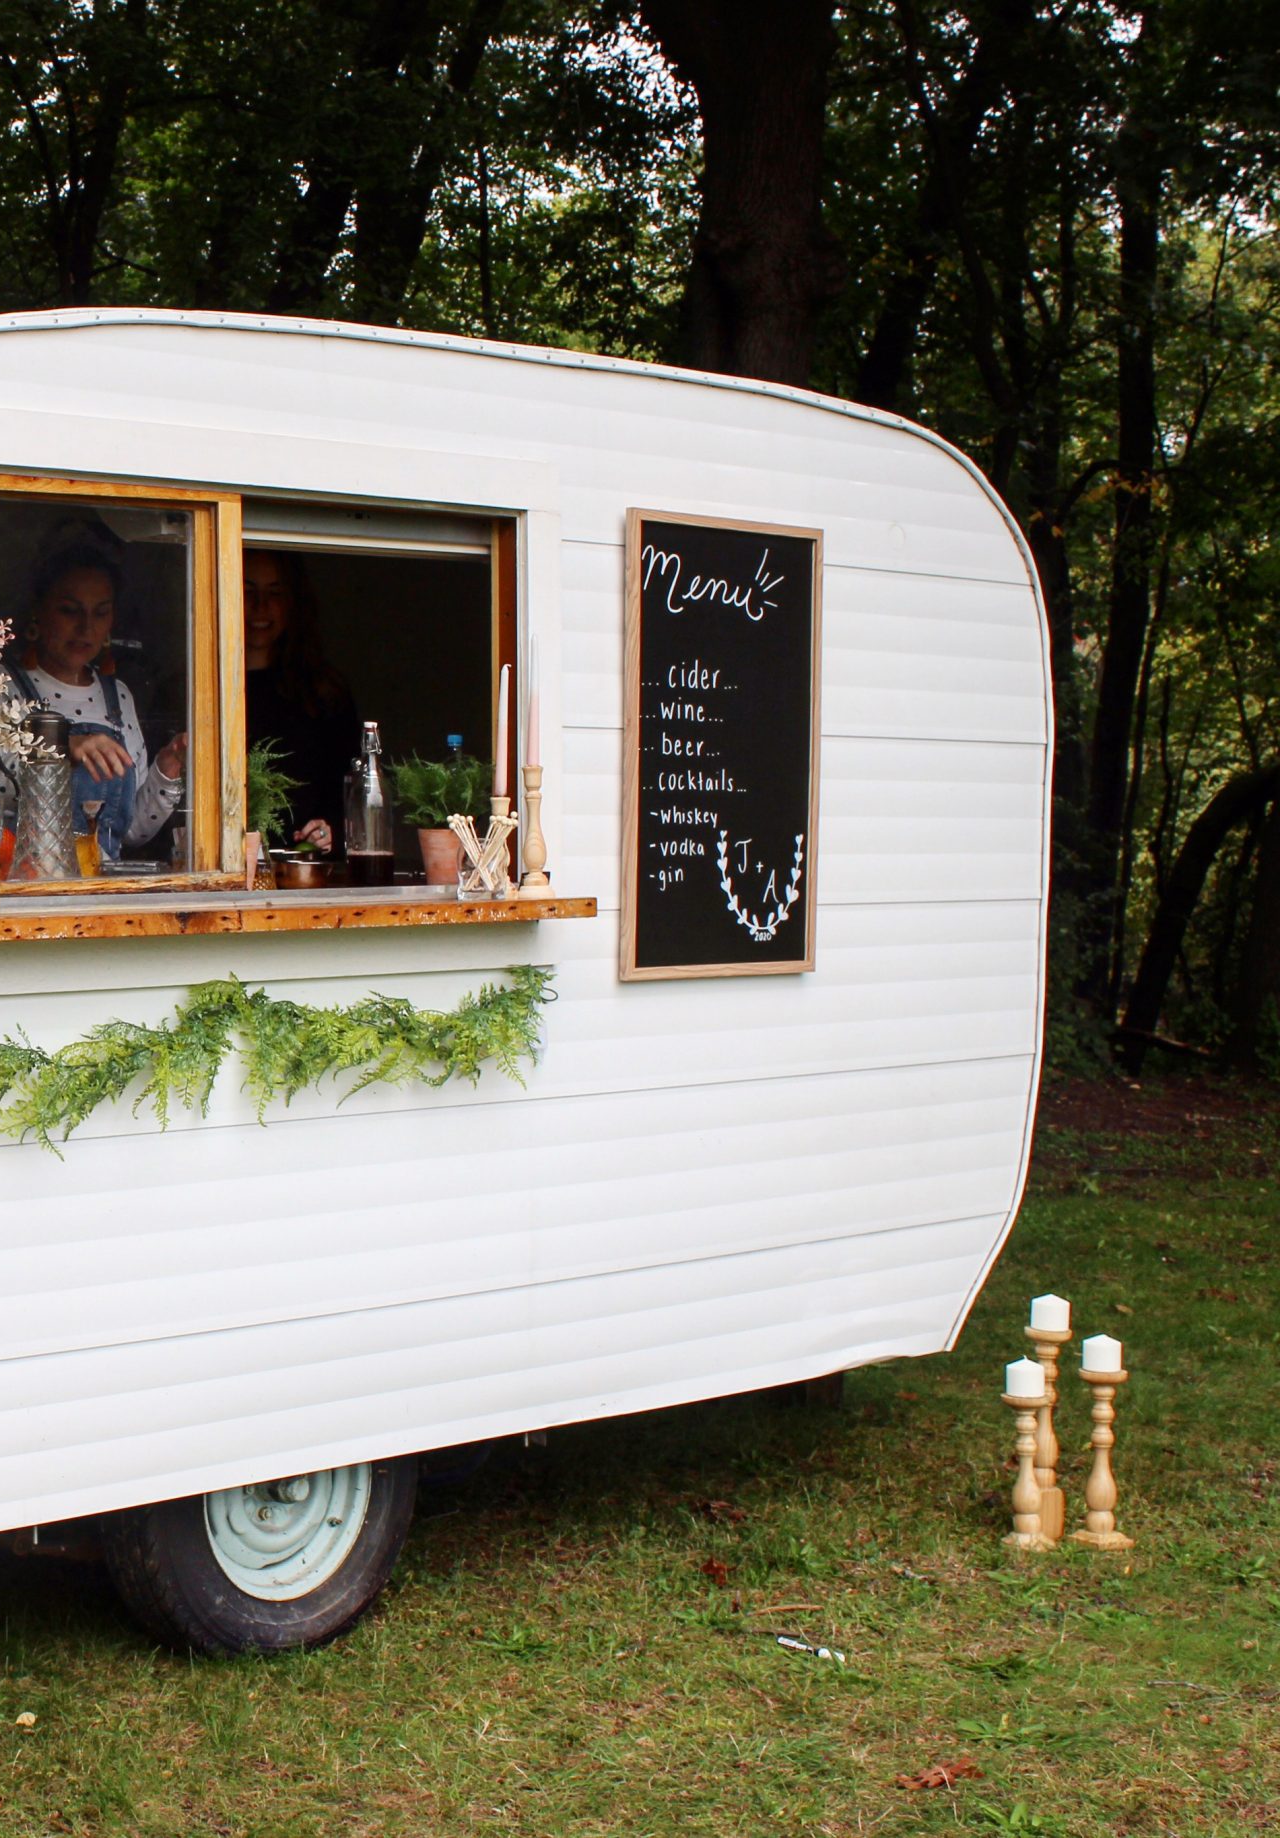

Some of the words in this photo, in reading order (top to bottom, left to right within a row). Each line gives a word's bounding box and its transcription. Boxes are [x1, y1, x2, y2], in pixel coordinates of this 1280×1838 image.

[641, 545, 764, 621] Menu
[734, 838, 753, 874] J
[762, 869, 780, 903] A
